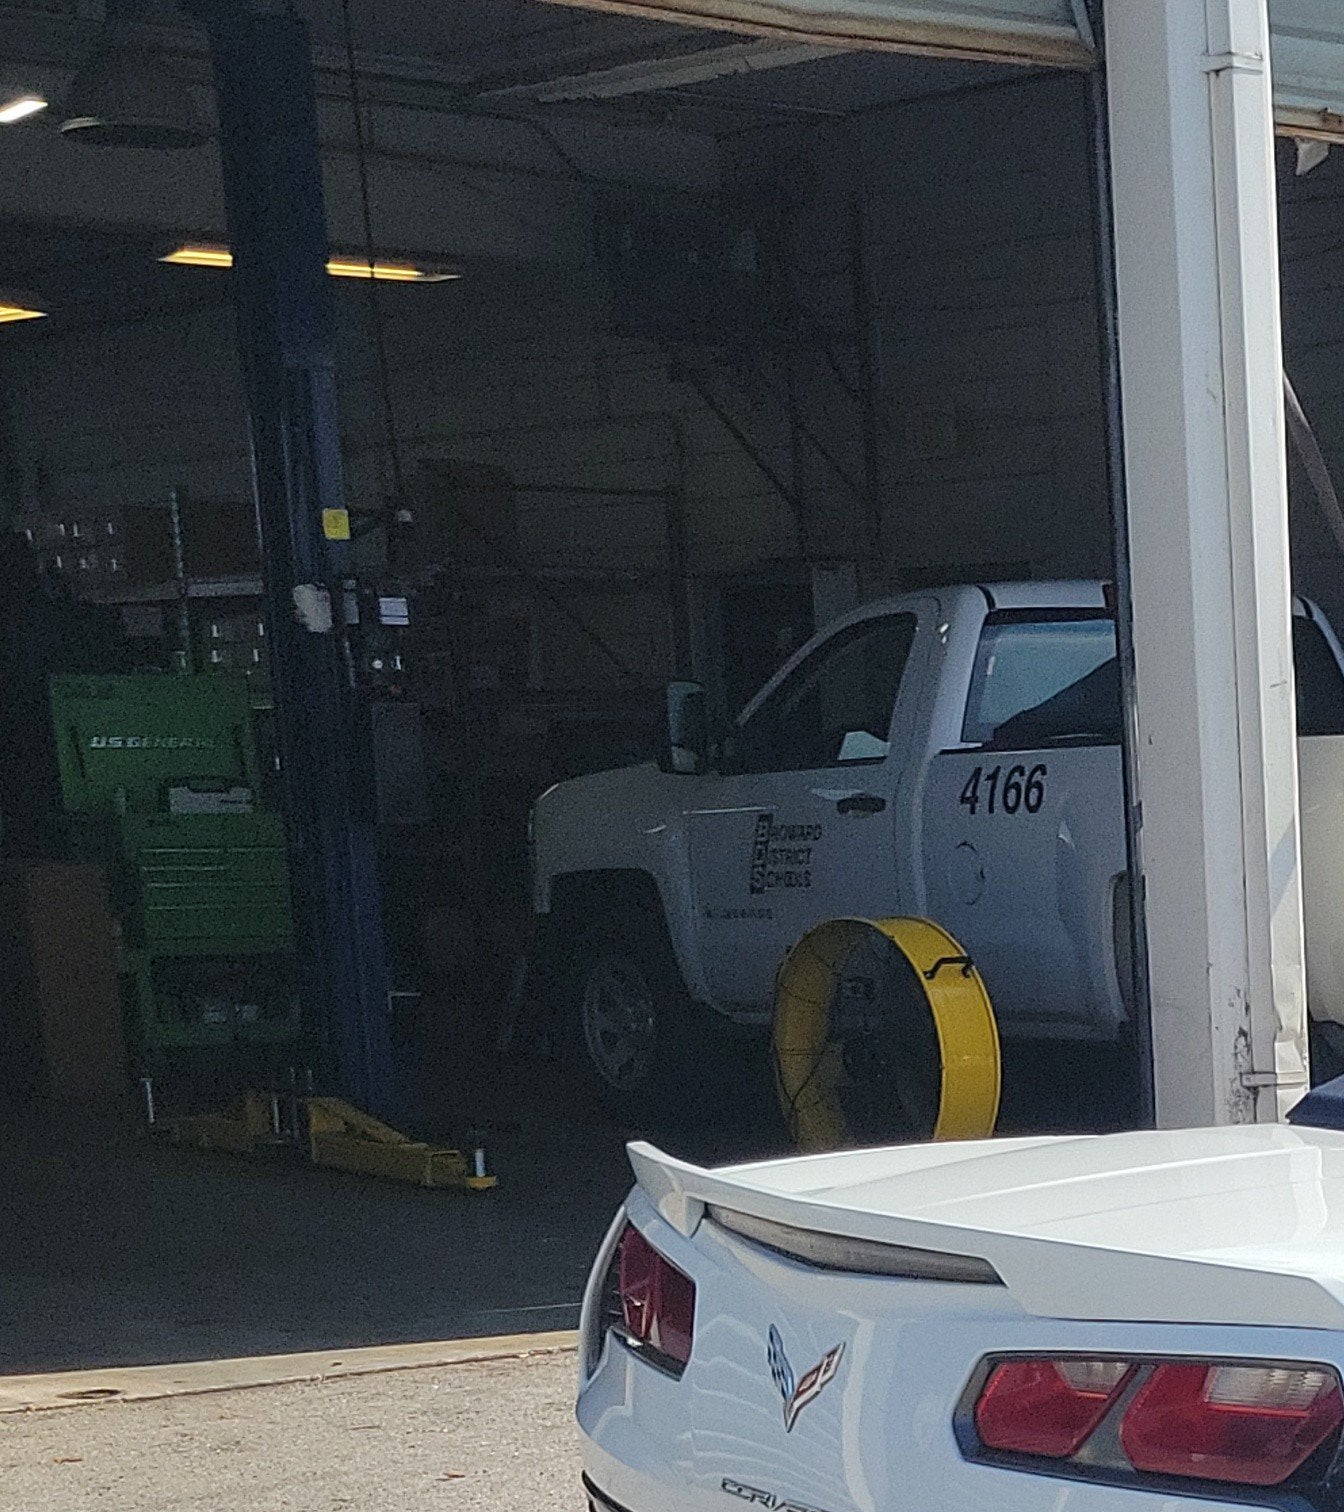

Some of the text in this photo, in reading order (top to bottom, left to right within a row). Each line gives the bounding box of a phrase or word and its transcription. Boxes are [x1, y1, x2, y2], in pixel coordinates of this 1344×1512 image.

[960, 763, 1047, 815] 4166
[755, 821, 823, 843] BROWARD
[753, 844, 813, 866] DISTRICT
[751, 867, 812, 889] SCHOOLS
